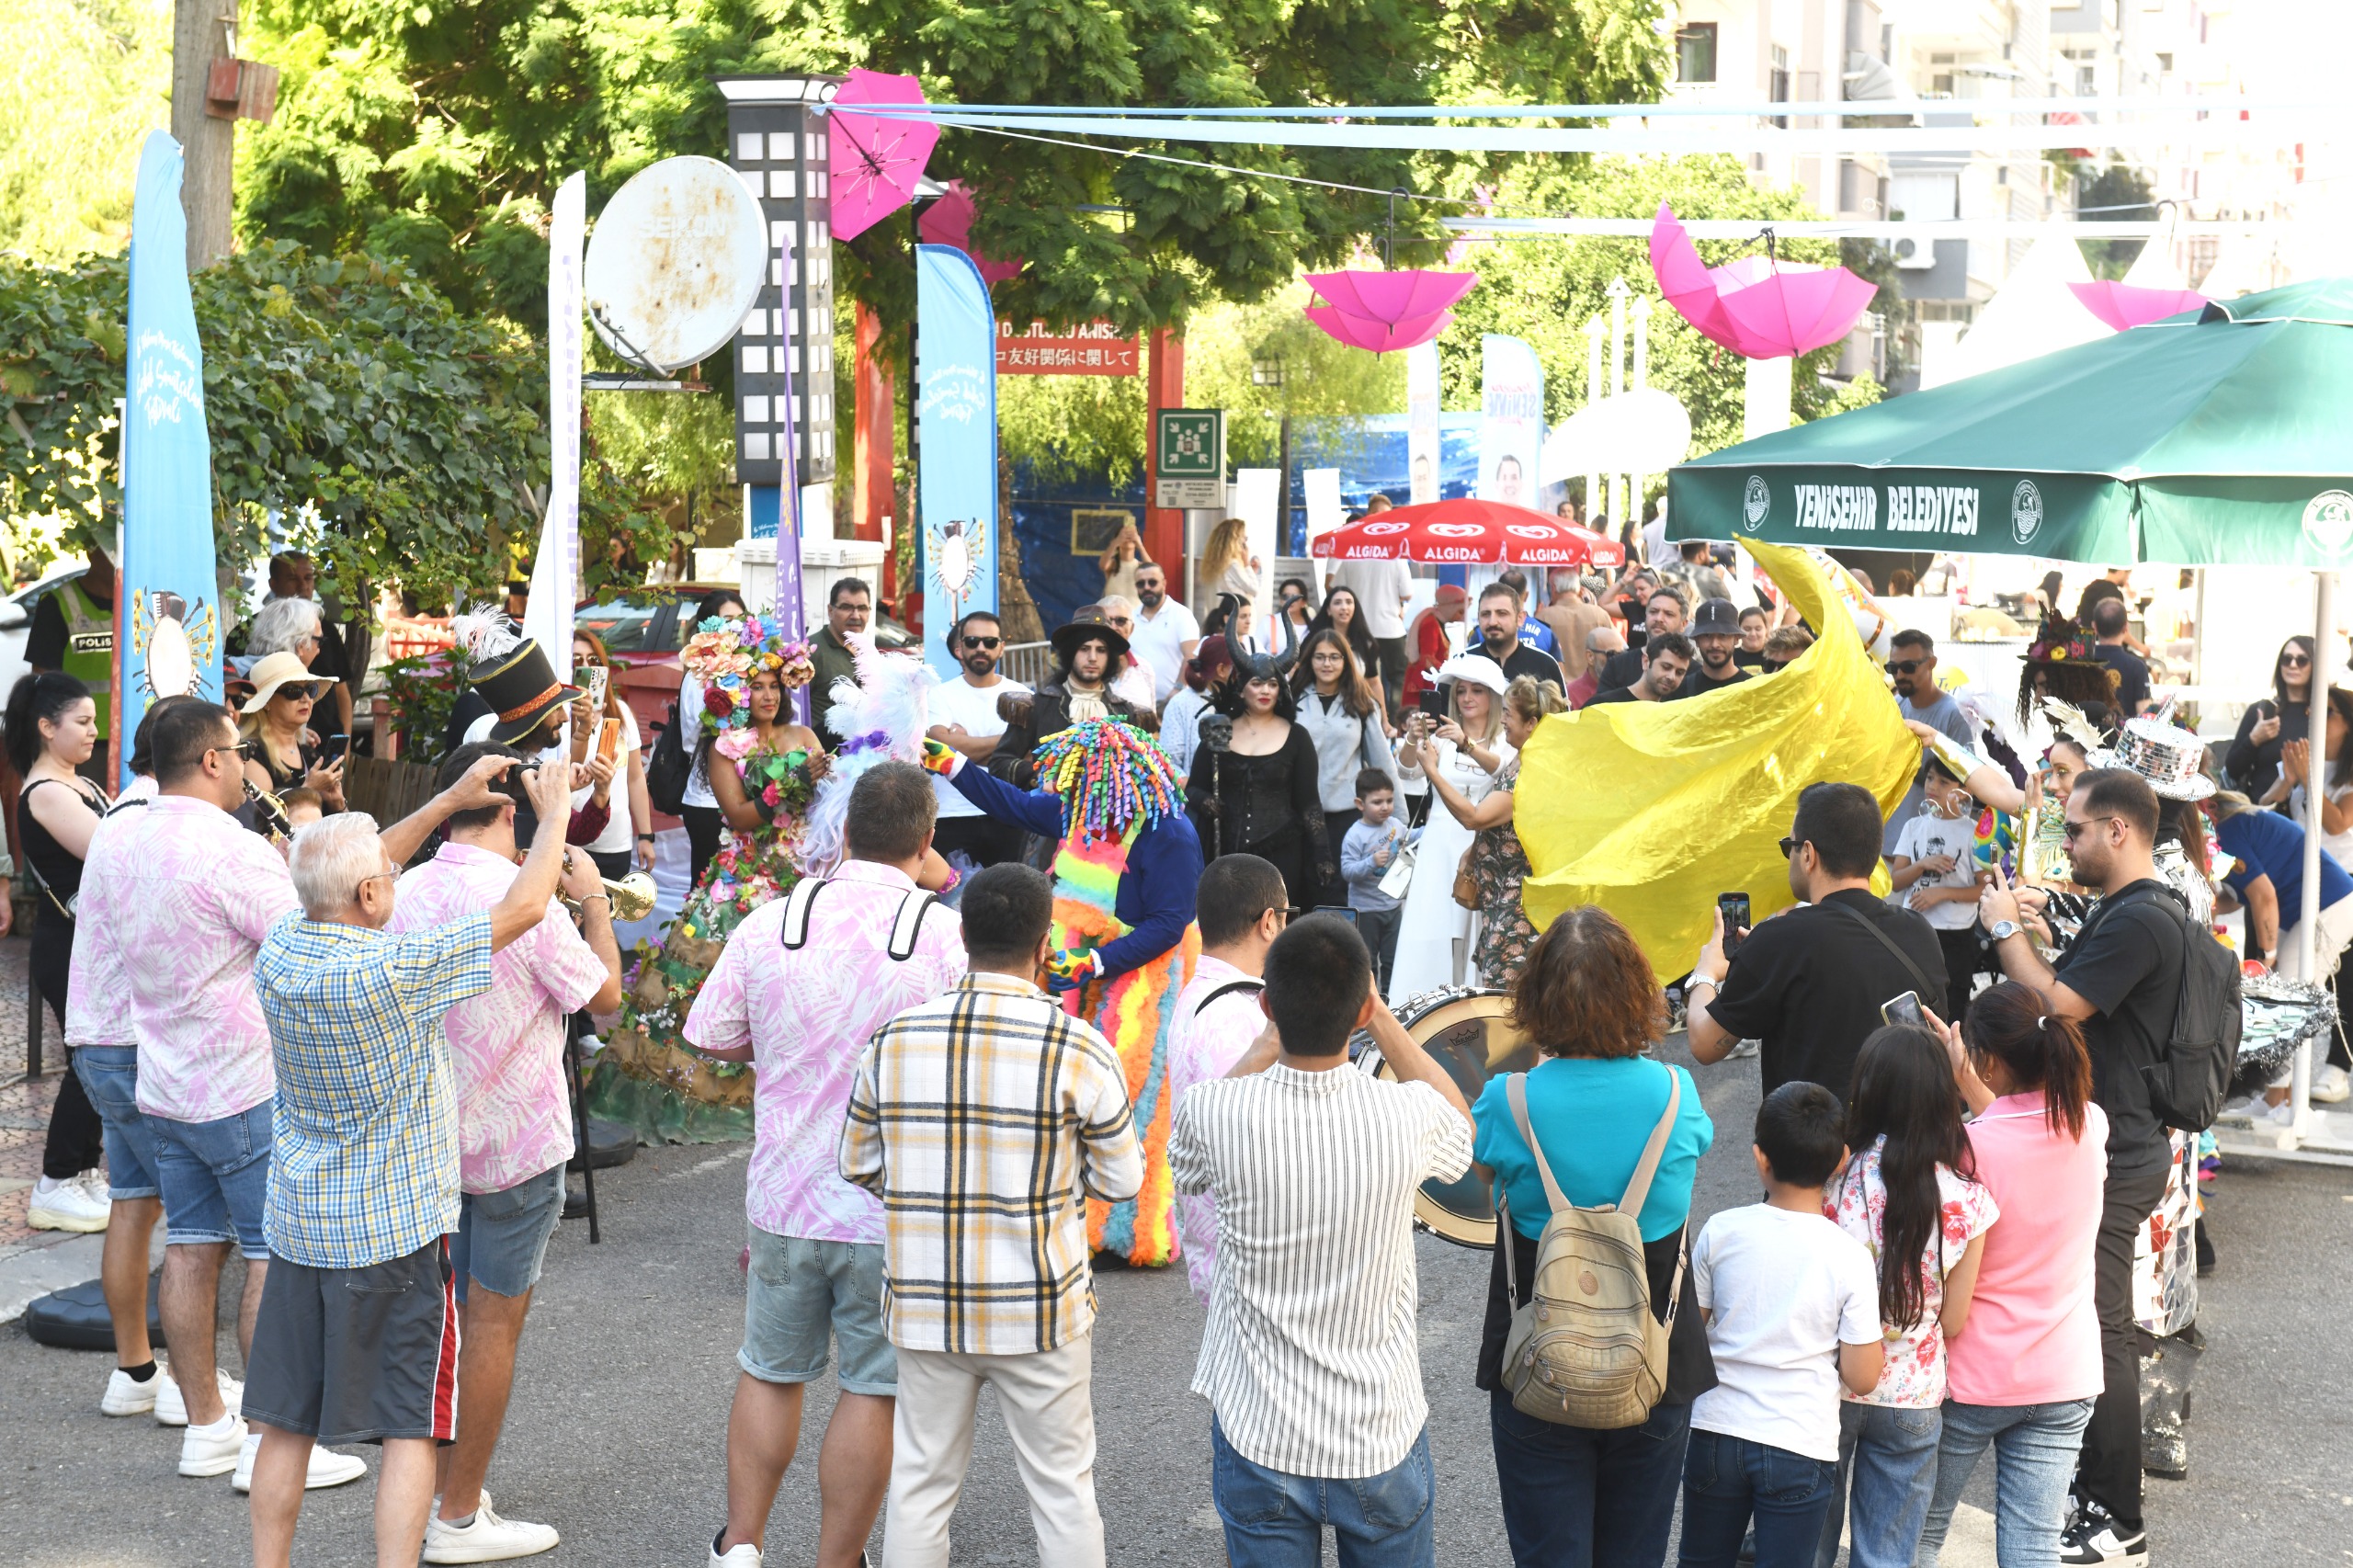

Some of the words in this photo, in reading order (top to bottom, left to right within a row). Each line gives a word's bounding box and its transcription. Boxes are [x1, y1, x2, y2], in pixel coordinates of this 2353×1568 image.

[1794, 484, 1877, 531] YENİŞEHİR
[1887, 485, 1980, 535] BELEDİYESİ
[1455, 1033, 1477, 1045] REMO
